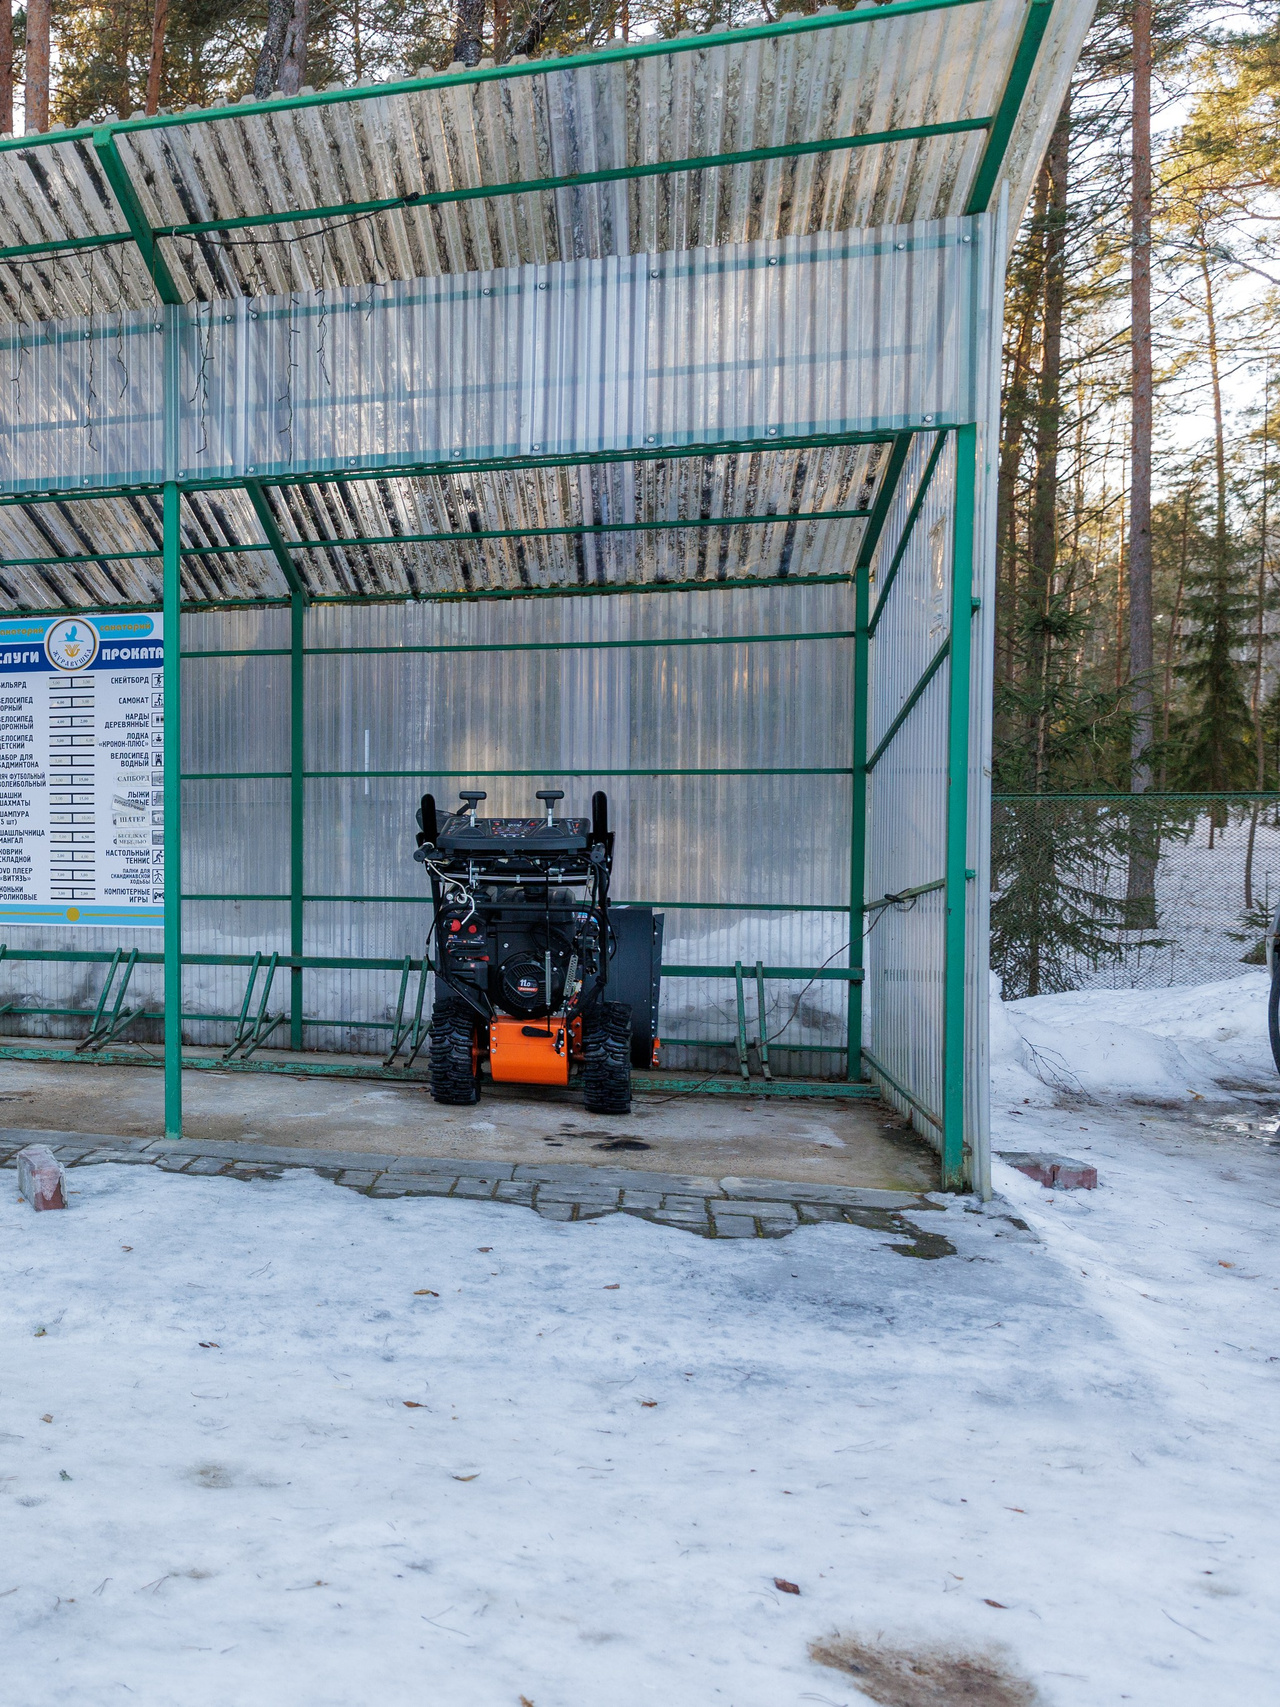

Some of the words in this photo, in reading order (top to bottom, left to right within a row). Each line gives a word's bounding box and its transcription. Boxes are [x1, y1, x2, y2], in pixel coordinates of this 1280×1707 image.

[100, 623, 151, 634] санаторий
[102, 647, 163, 661] ПРОКАТА
[111, 676, 149, 684] СКЕЙТБОРД
[105, 721, 149, 729] ДЕРЕВЯННЫЕ
[111, 752, 149, 760] ВЕЛОСИПЕД
[121, 760, 149, 768] ВОДНЫЙ
